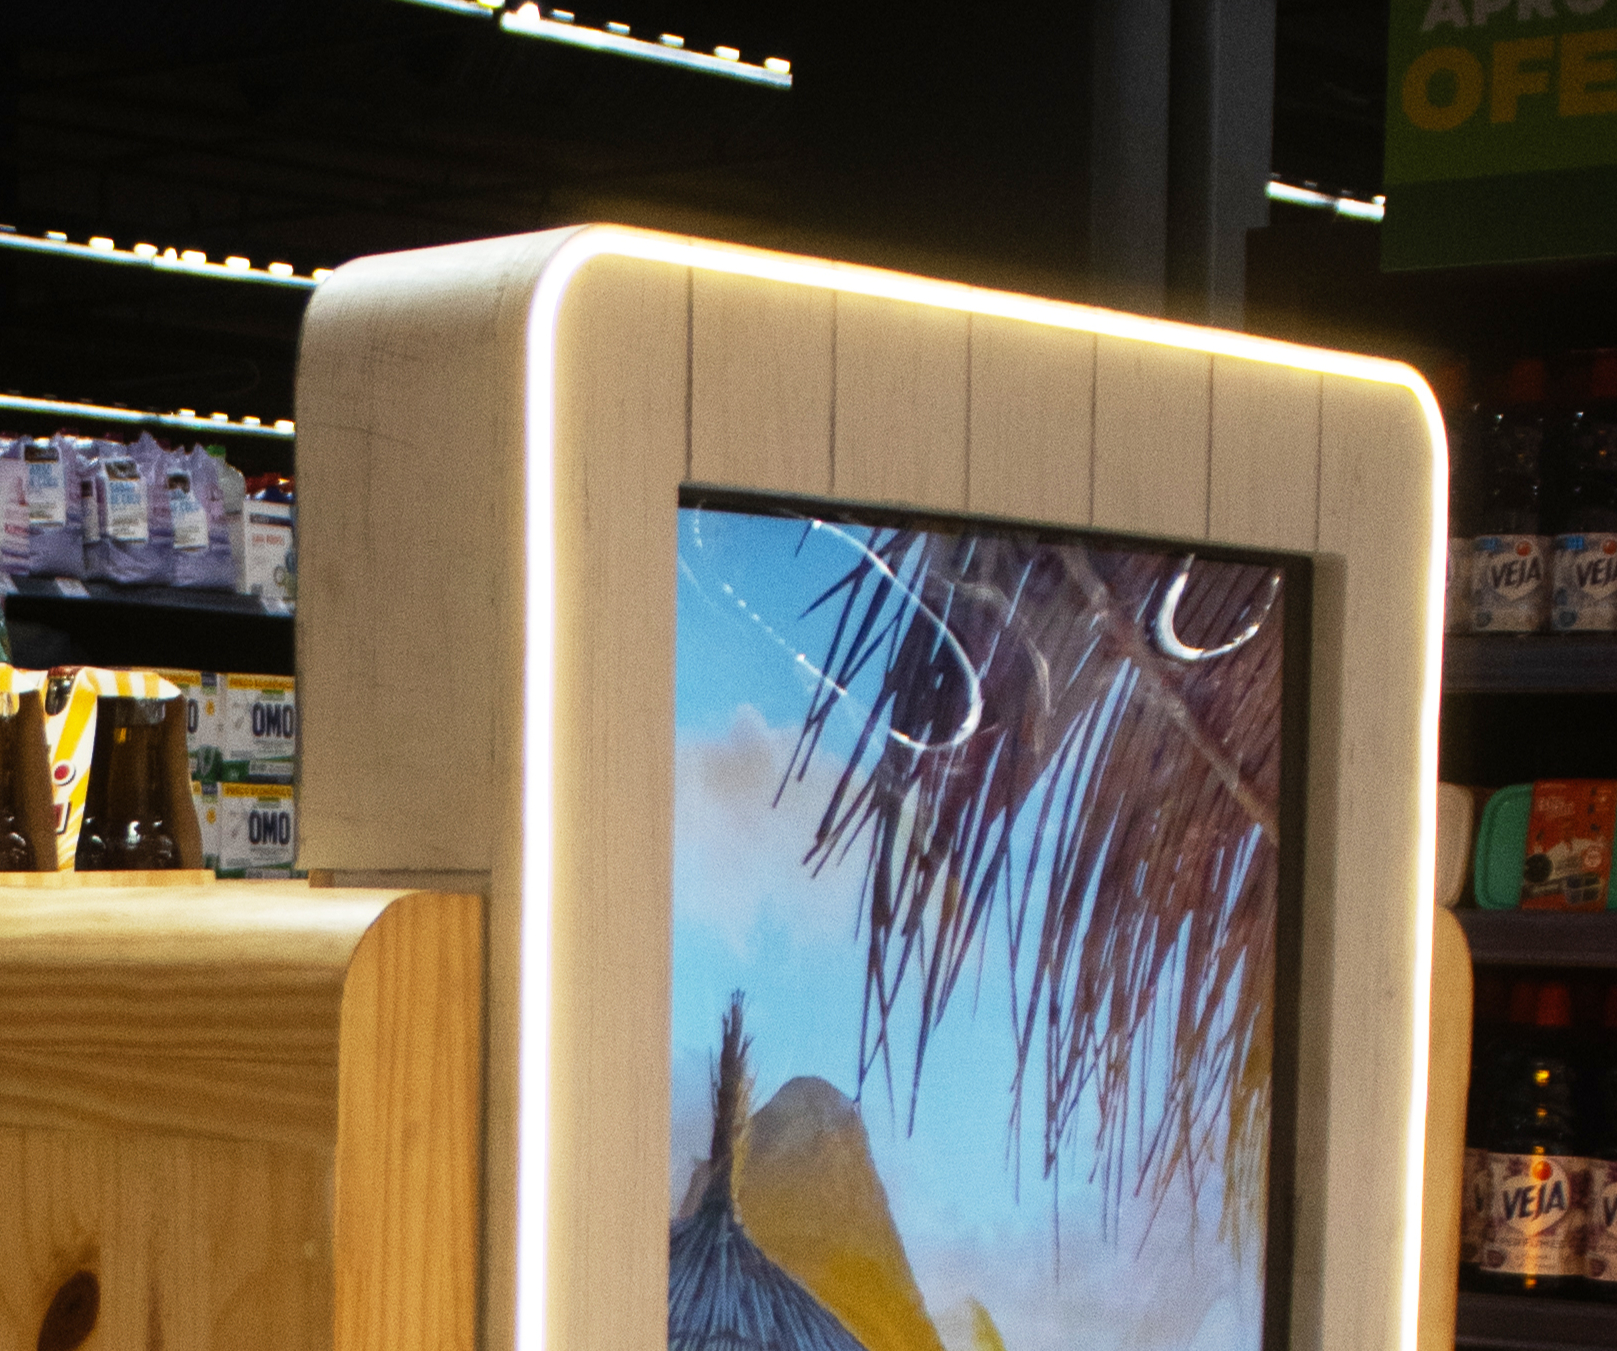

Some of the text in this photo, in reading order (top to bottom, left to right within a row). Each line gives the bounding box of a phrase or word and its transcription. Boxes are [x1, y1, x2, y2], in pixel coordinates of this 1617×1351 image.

[1492, 557, 1543, 590] VEJA
[252, 703, 294, 737] OMO
[249, 811, 291, 844] OMO
[1503, 1180, 1567, 1222] VEJA
